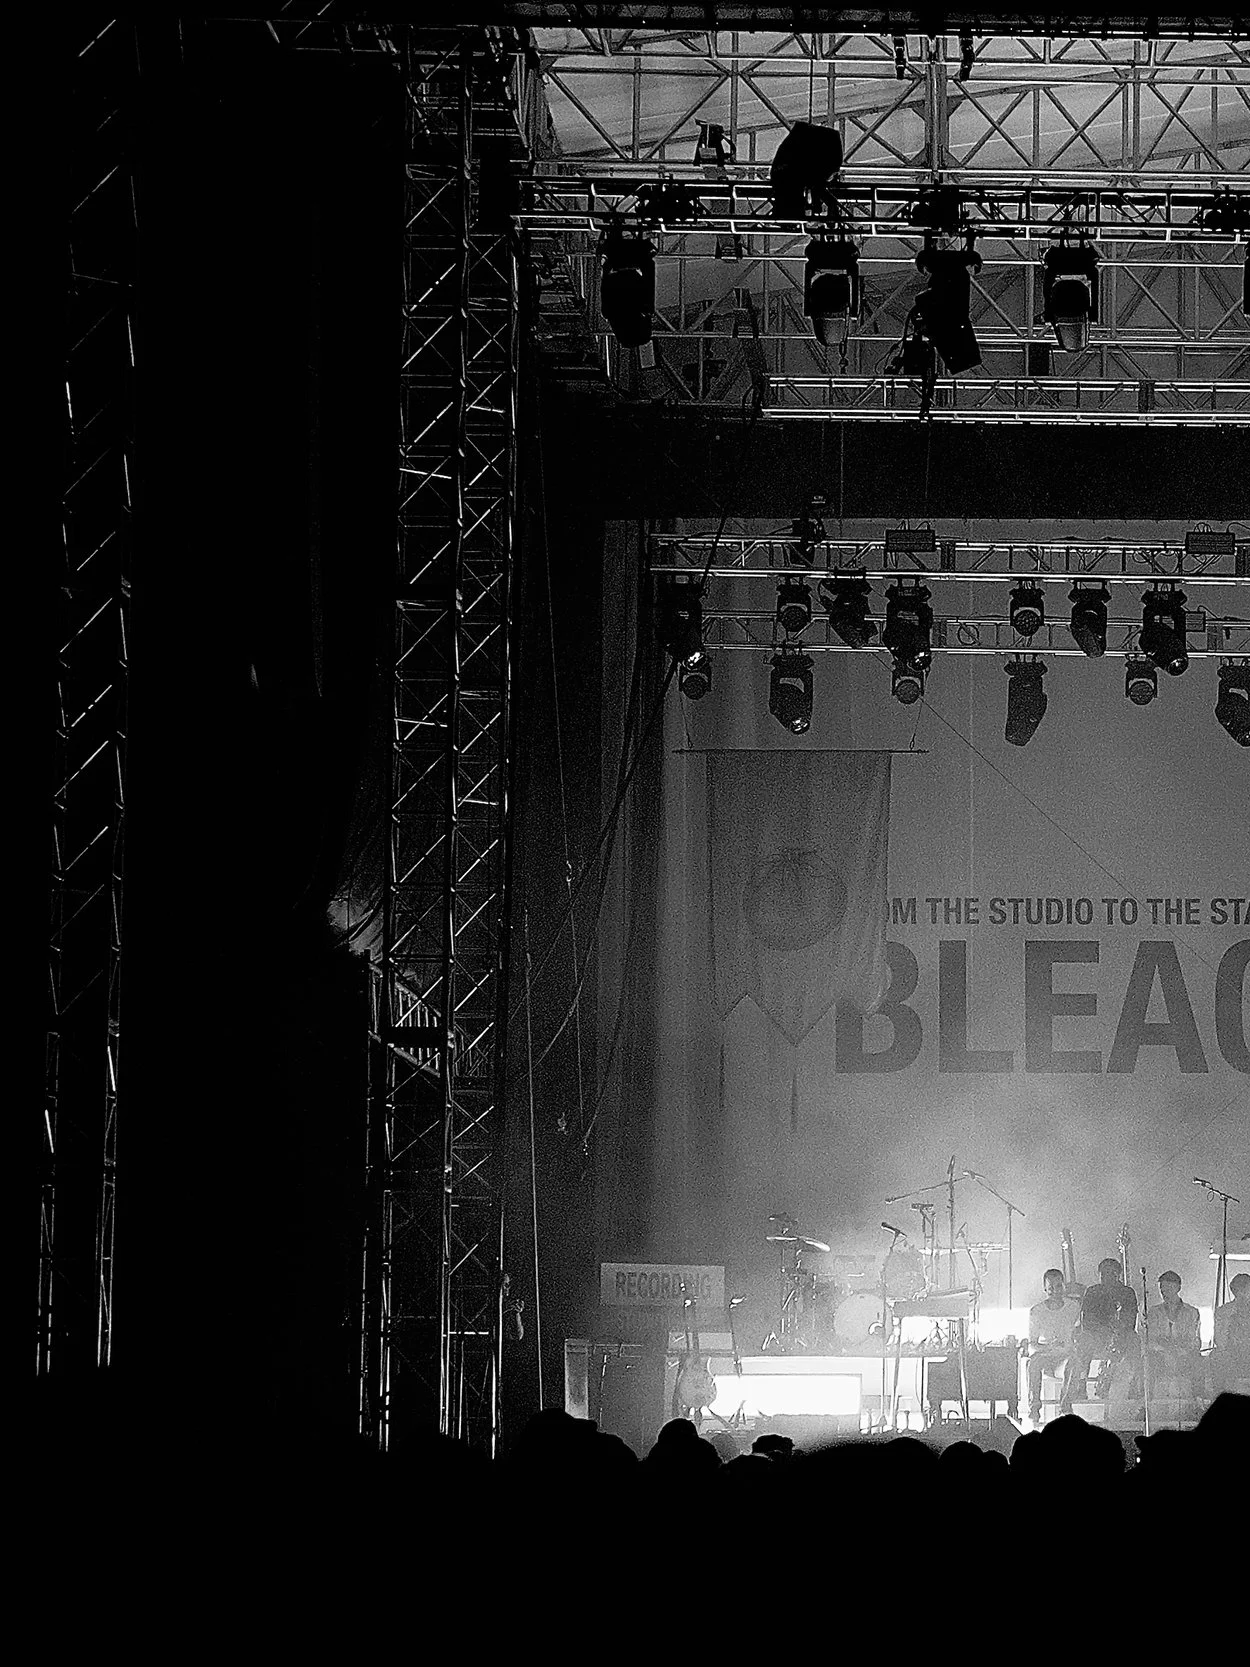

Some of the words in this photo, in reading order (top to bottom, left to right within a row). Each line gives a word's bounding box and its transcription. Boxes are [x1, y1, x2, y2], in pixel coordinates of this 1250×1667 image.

[926, 898, 979, 925] THE
[989, 897, 1093, 926] STUDIO
[1102, 898, 1138, 926] TO
[1149, 898, 1200, 925] THE
